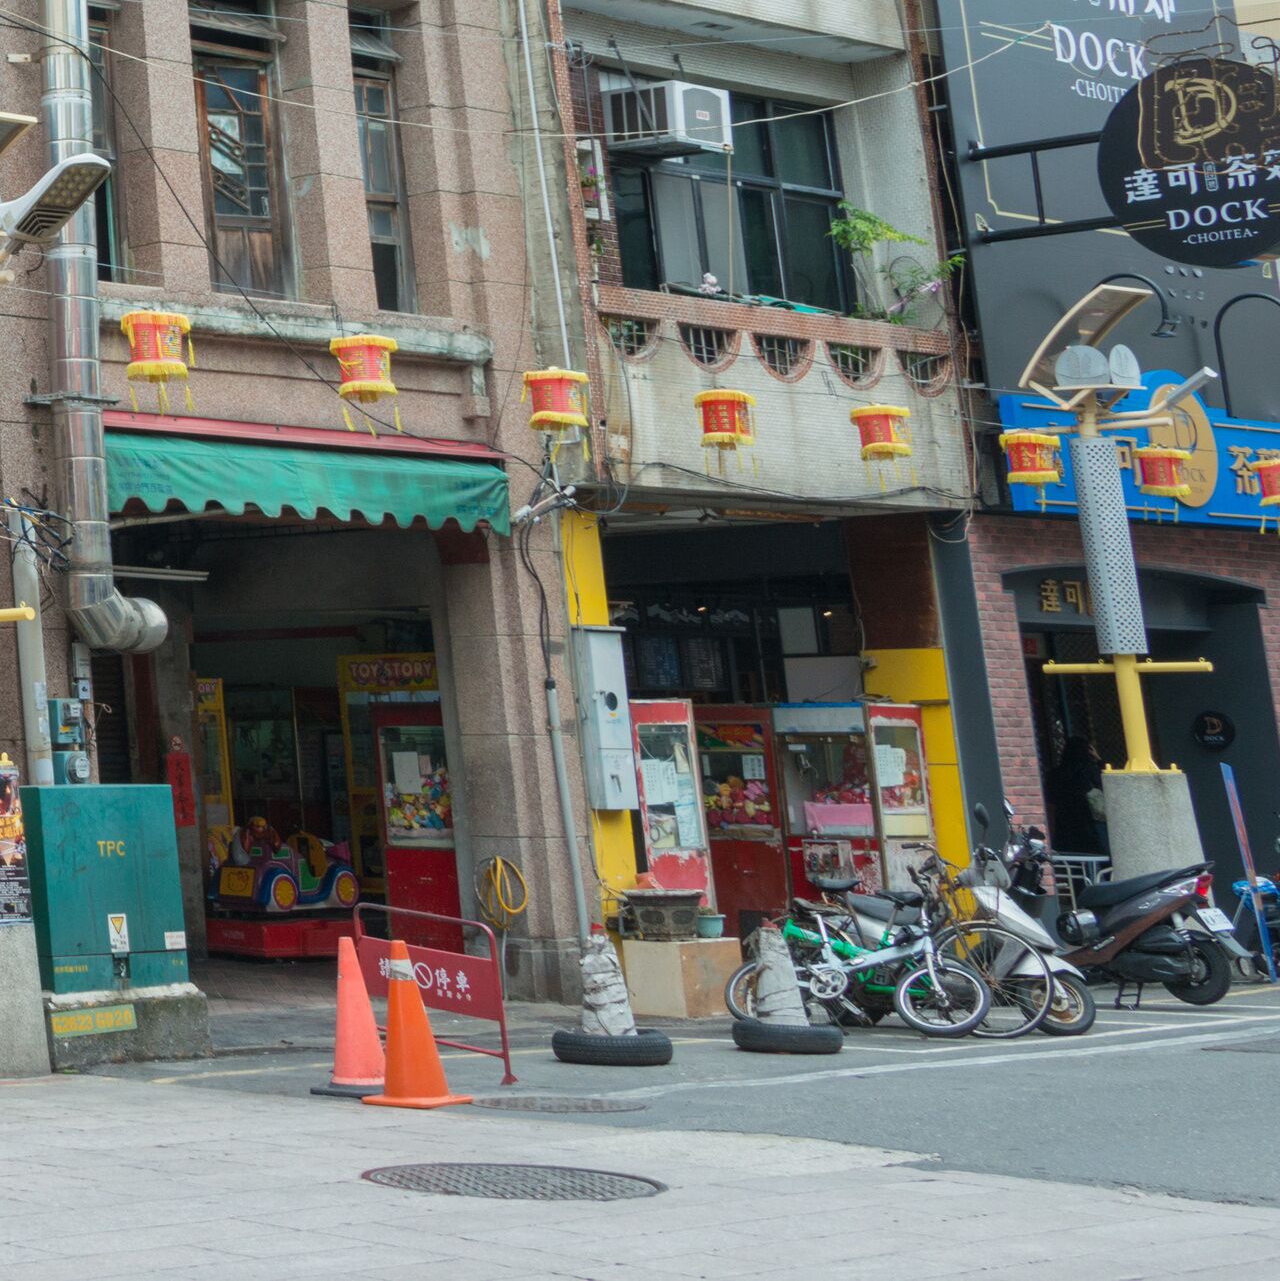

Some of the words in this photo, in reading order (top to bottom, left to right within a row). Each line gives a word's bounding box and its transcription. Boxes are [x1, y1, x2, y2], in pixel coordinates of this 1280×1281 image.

[1051, 23, 1150, 81] DOCK
[1166, 197, 1270, 232] DOCK
[349, 662, 379, 679] TOY
[382, 659, 433, 678] STORY
[96, 840, 126, 857] TPC
[434, 967, 471, 993] 停車
